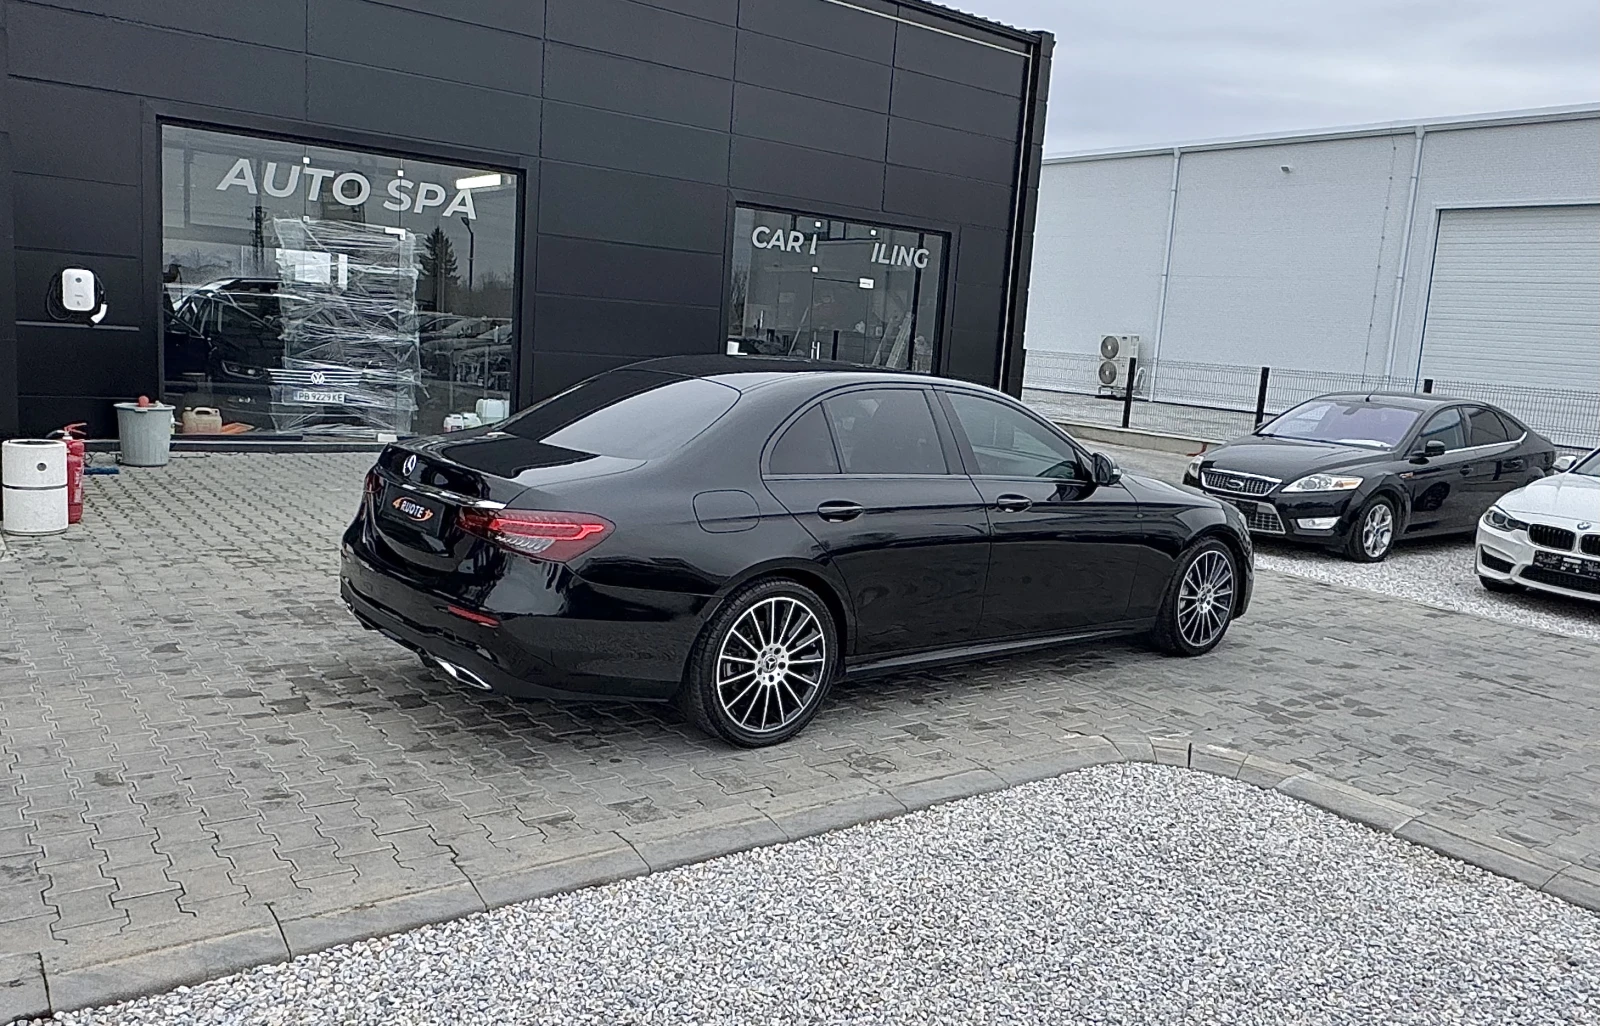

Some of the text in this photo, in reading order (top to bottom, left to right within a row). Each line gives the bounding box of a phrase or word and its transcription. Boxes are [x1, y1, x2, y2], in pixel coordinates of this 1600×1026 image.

[216, 158, 477, 220] AUTO SPA
[752, 226, 804, 253] CAR
[400, 500, 425, 518] RUOTE
